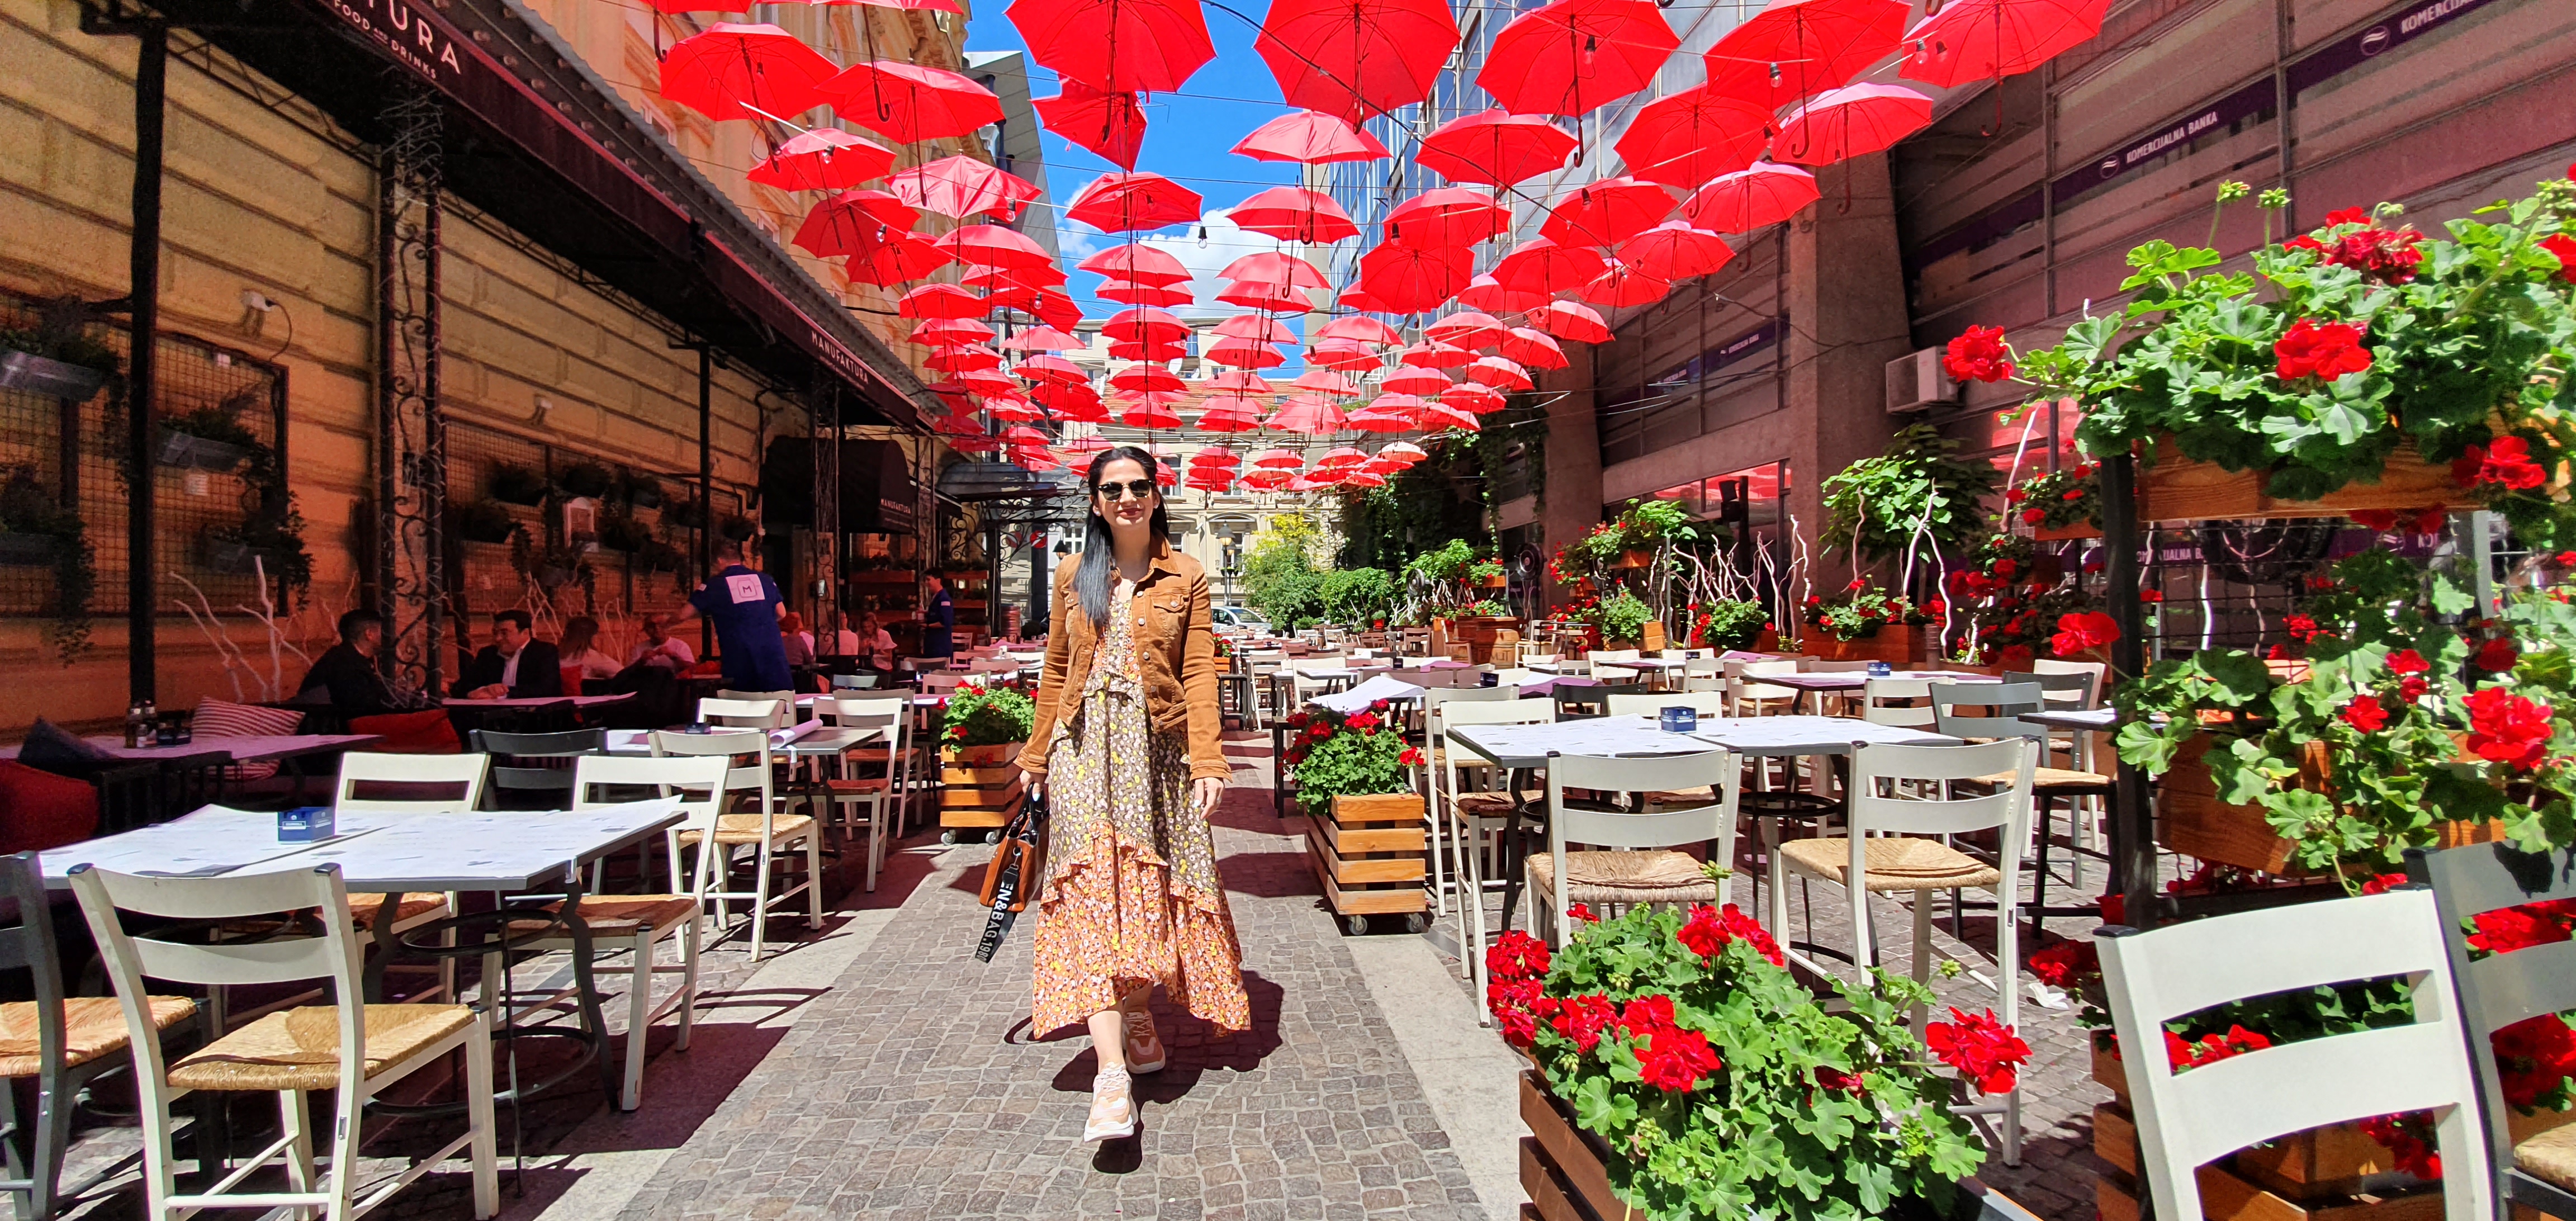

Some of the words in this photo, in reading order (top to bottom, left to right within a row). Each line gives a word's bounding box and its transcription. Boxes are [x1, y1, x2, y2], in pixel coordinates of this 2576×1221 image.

[369, 0, 461, 74] URA
[391, 40, 436, 79] DRINKS
[2127, 127, 2185, 164] KOMERCIJALNA
[2188, 111, 2218, 135] BANKA
[812, 330, 868, 385] MANUFAKTURA
